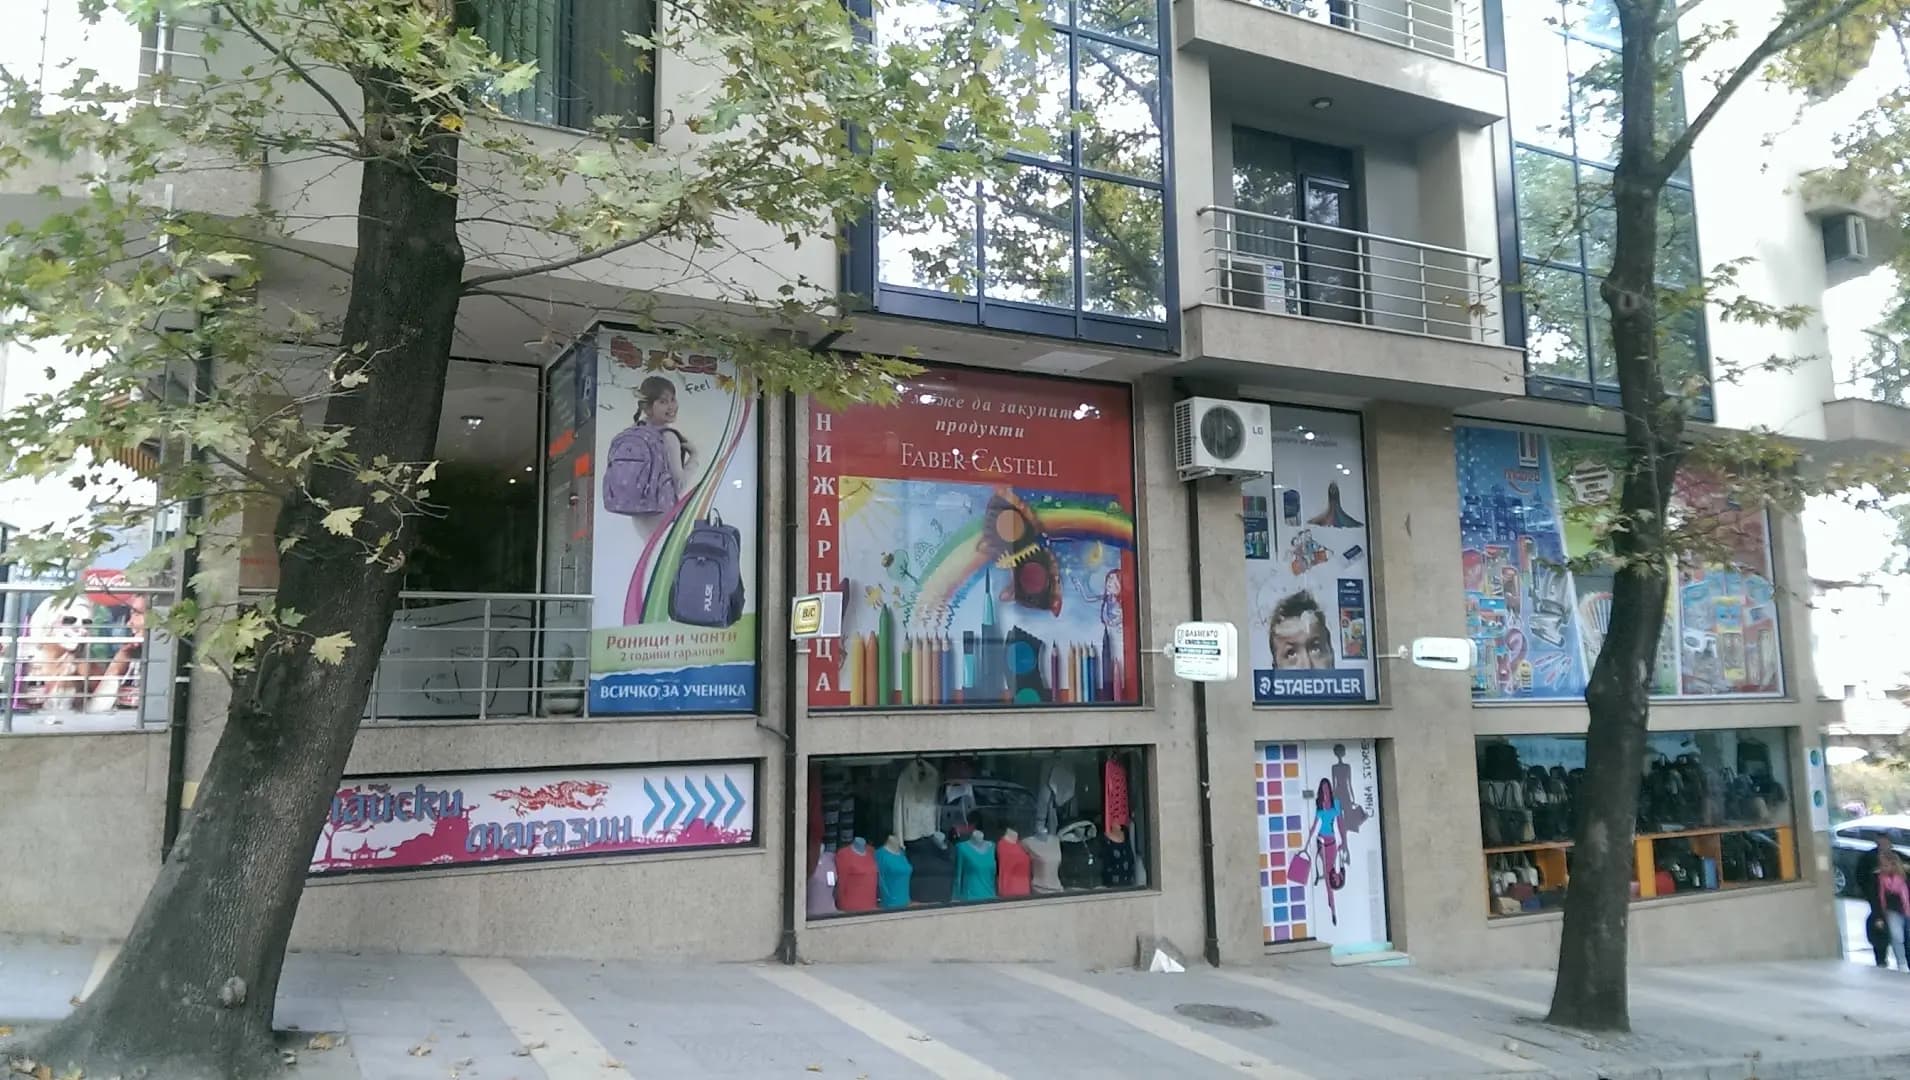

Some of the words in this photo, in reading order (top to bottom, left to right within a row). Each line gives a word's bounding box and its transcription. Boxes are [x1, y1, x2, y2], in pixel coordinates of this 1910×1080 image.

[685, 380, 712, 396] Feel
[911, 394, 965, 409] мже
[971, 398, 992, 412] да
[1000, 402, 1086, 420] закупит
[935, 419, 1026, 438] продукти
[1252, 425, 1264, 436] LG
[606, 635, 670, 651] Раници
[675, 635, 685, 646] и
[690, 631, 738, 645] чанти
[620, 652, 627, 662] 2
[630, 650, 671, 662] години
[673, 647, 726, 661] гаранция
[600, 685, 659, 700] ВСИЧКО
[661, 684, 679, 698] ЗА
[683, 683, 747, 698] УЧЕНИКА
[1273, 678, 1361, 696] STAEDTLER
[1361, 742, 1372, 780] STORE
[331, 783, 465, 824] айски
[465, 815, 634, 854] магазин
